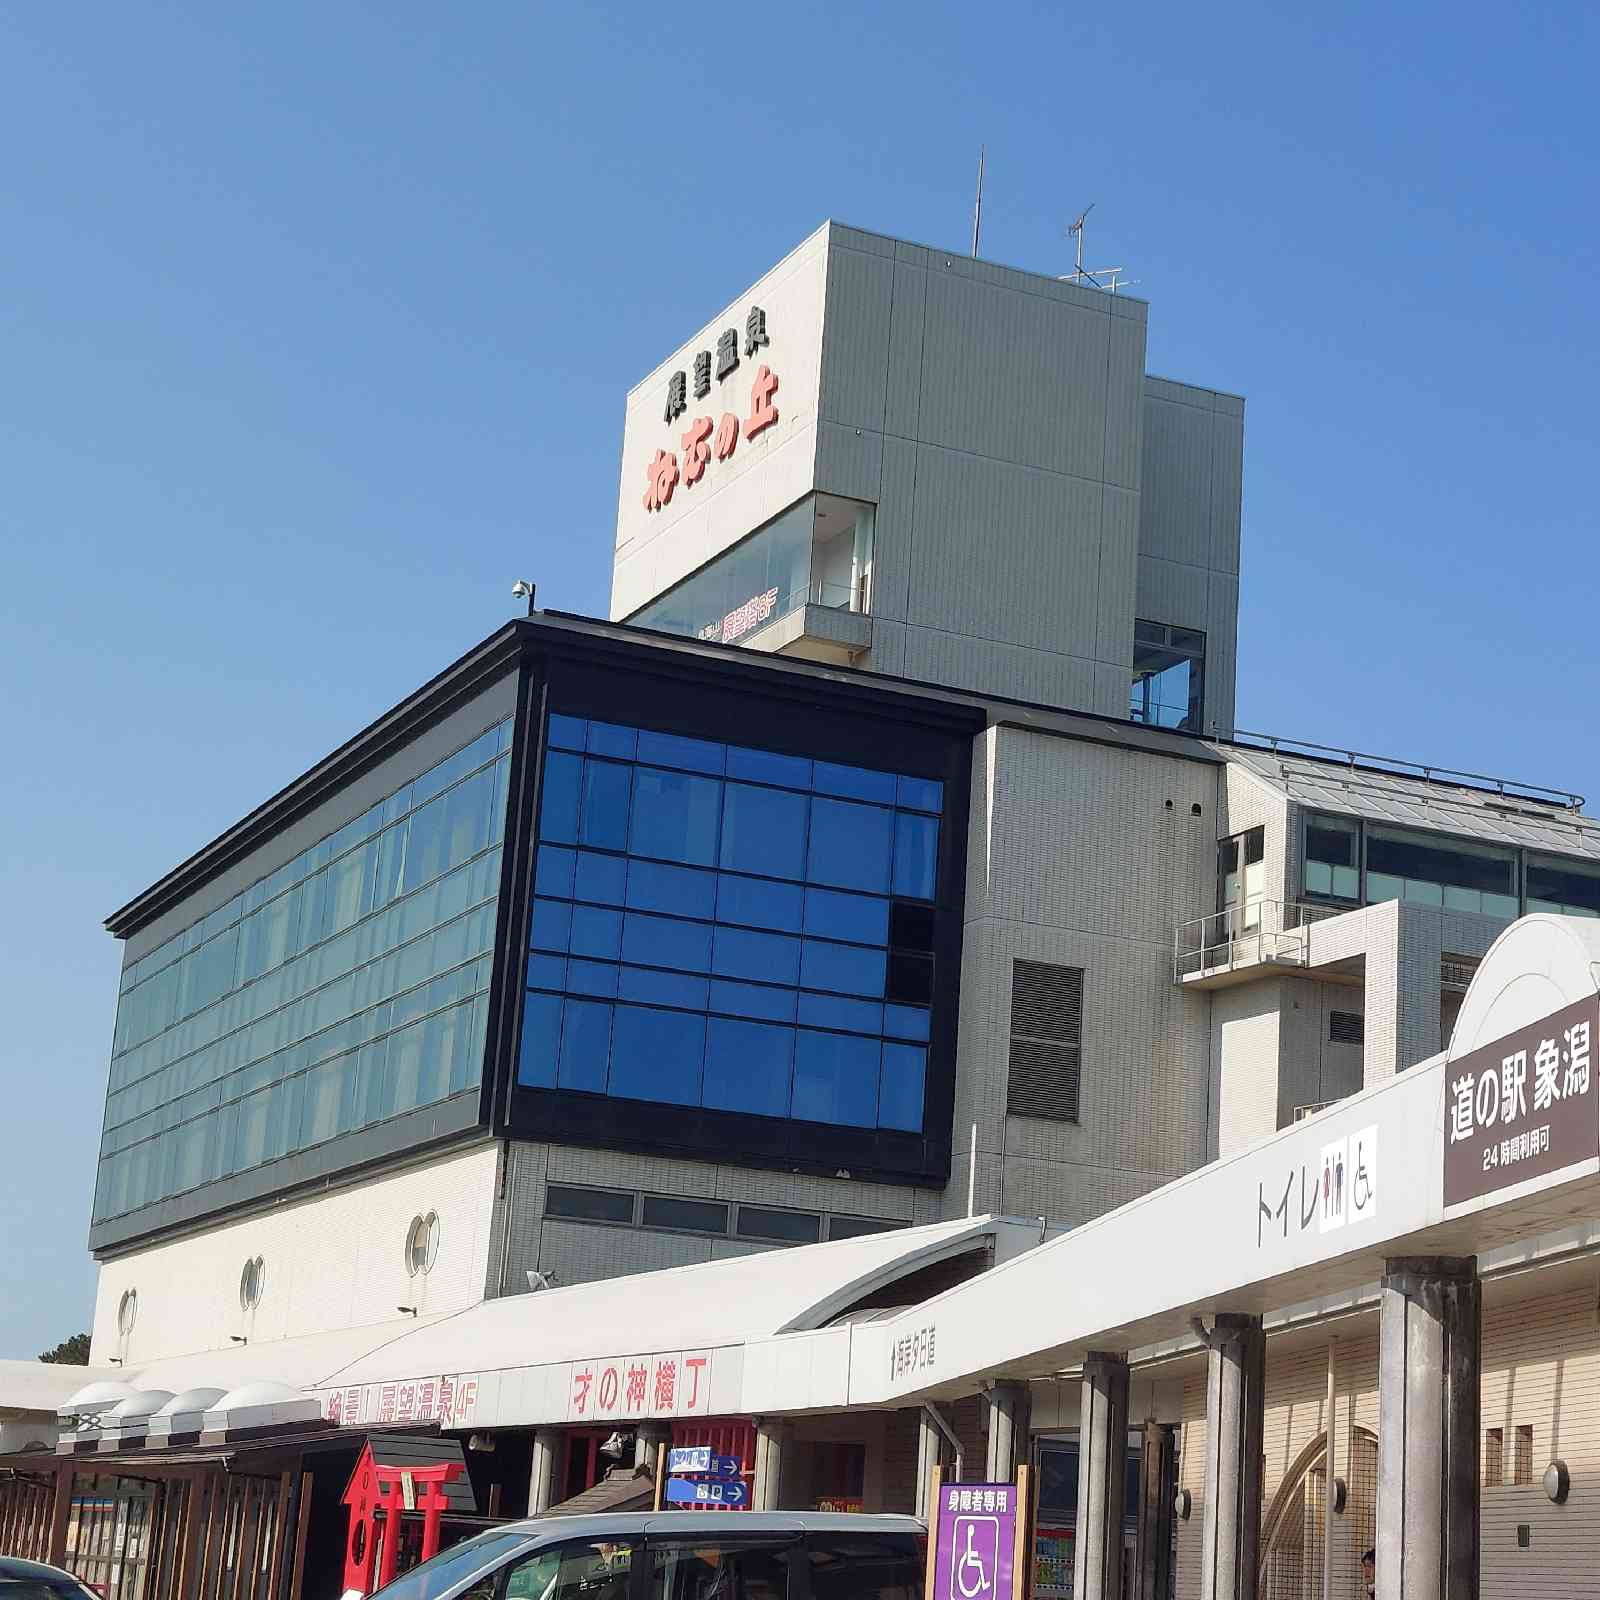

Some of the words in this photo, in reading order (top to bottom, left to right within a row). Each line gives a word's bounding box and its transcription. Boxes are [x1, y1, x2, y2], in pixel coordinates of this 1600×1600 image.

[664, 305, 769, 425] 展望温泉
[1450, 1049, 1527, 1144] 道の駅
[1534, 1020, 1590, 1111] 象潟
[1258, 1165, 1319, 1248] トイレ
[574, 1358, 706, 1414] 才の神横丁
[948, 1489, 1008, 1512] 身障者専用
